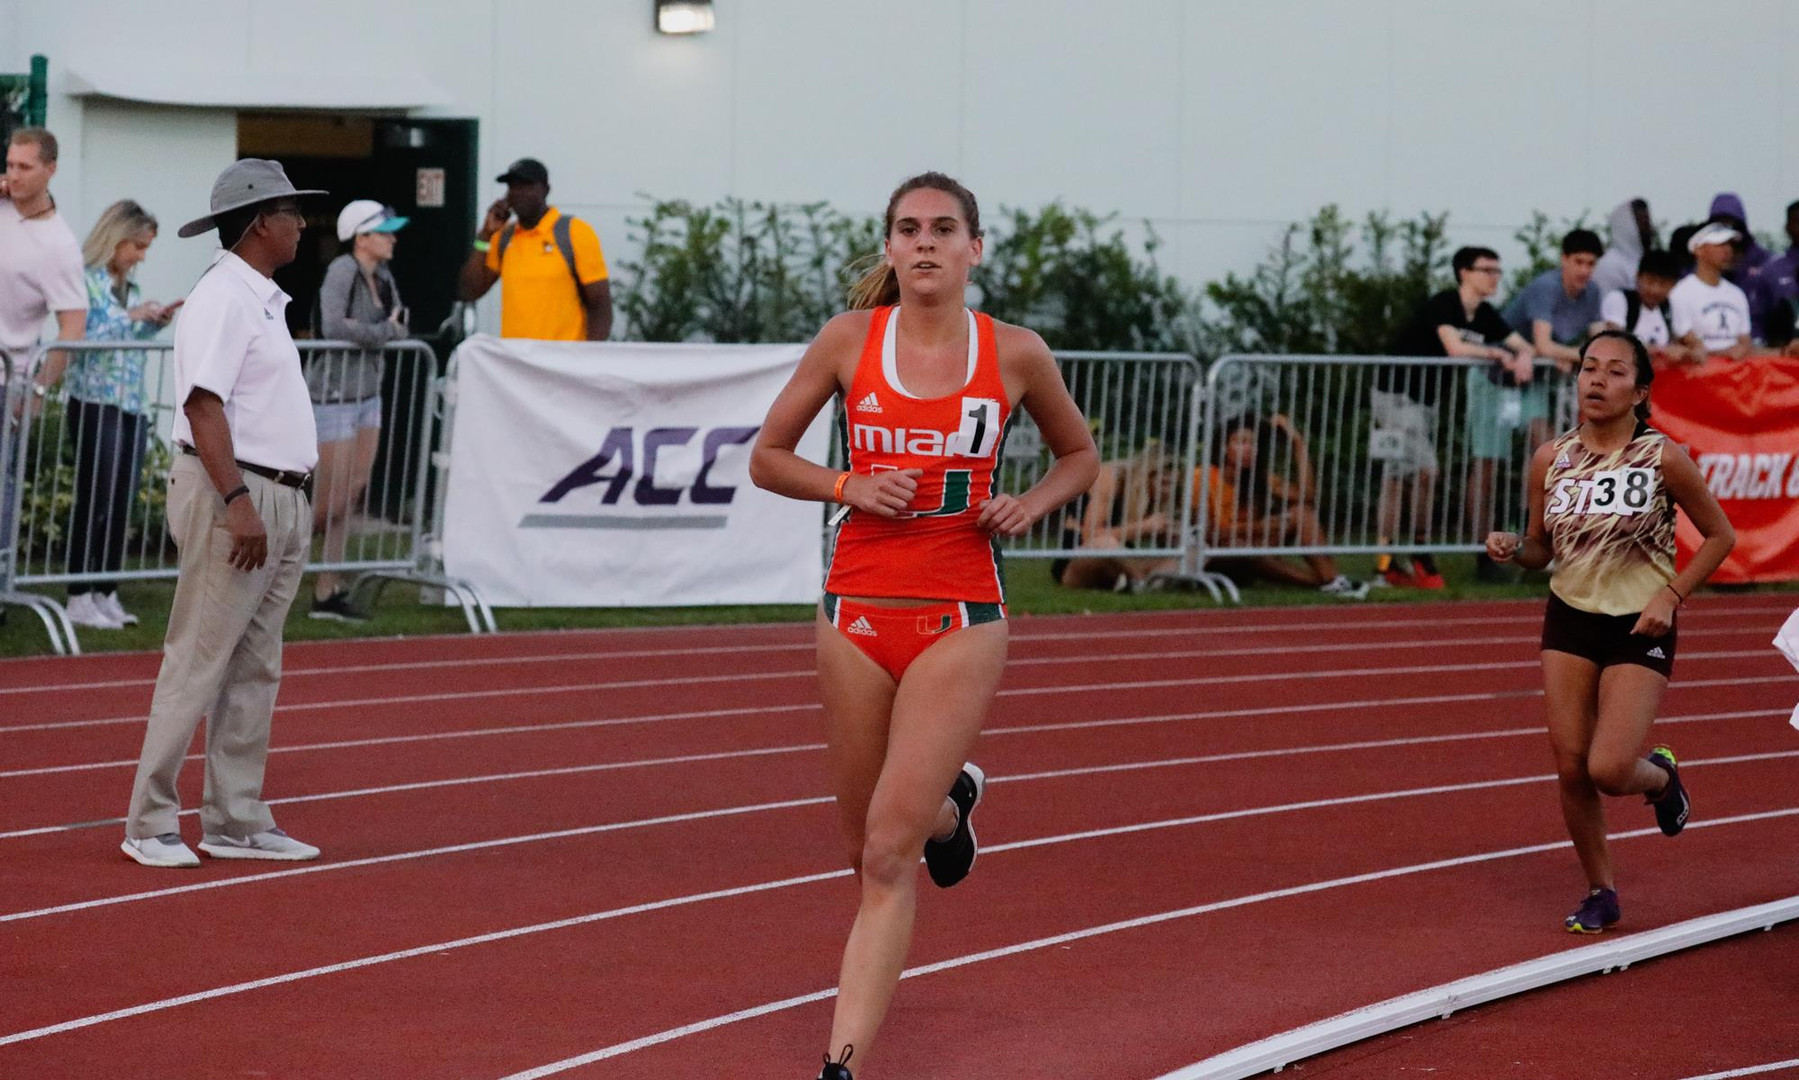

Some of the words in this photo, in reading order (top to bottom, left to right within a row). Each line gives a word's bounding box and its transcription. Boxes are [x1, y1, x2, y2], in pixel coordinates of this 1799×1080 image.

[856, 405, 883, 414] adidas
[968, 404, 987, 454] 1
[538, 426, 762, 505] ACC
[1697, 453, 1791, 499] TRACK
